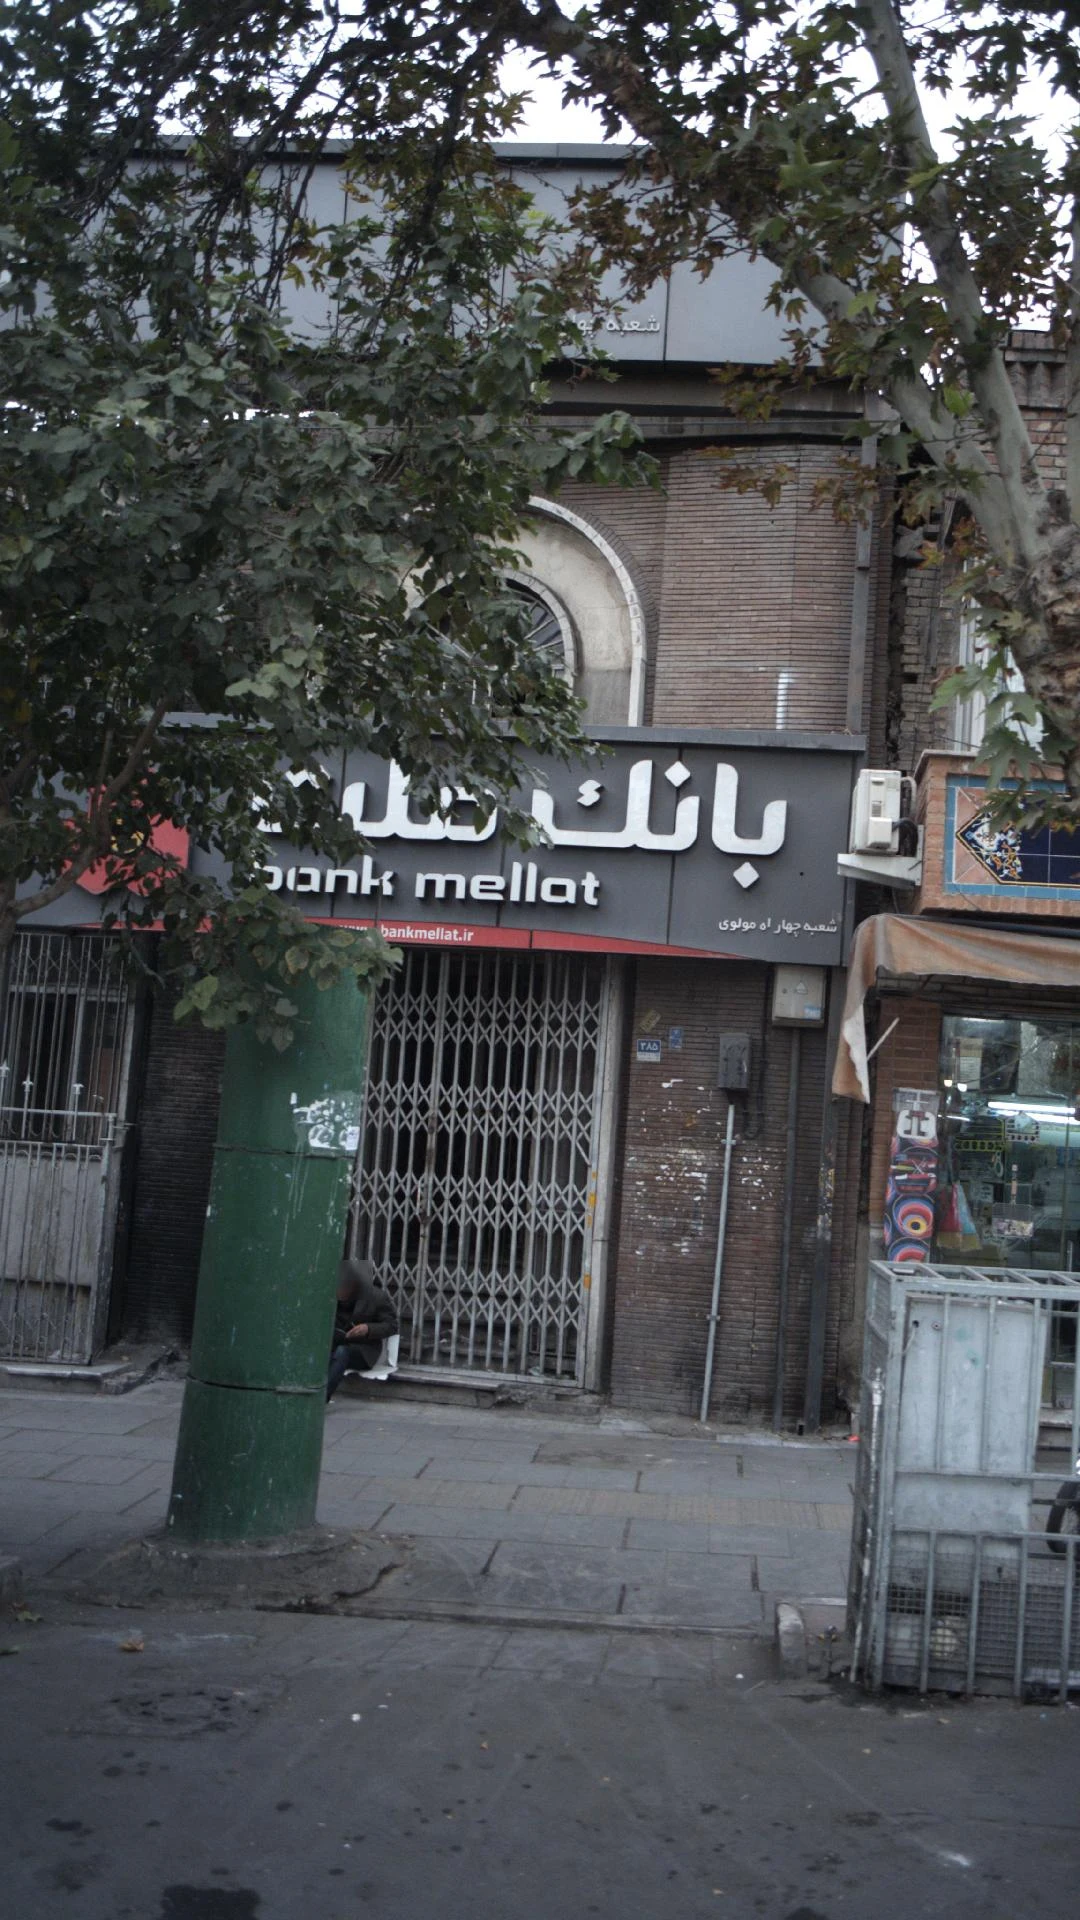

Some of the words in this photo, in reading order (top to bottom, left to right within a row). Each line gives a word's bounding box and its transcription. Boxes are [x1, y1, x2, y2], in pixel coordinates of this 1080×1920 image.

[414, 861, 600, 906] mellat
[718, 917, 757, 932] مولوی
[803, 917, 838, 936] شعبه
